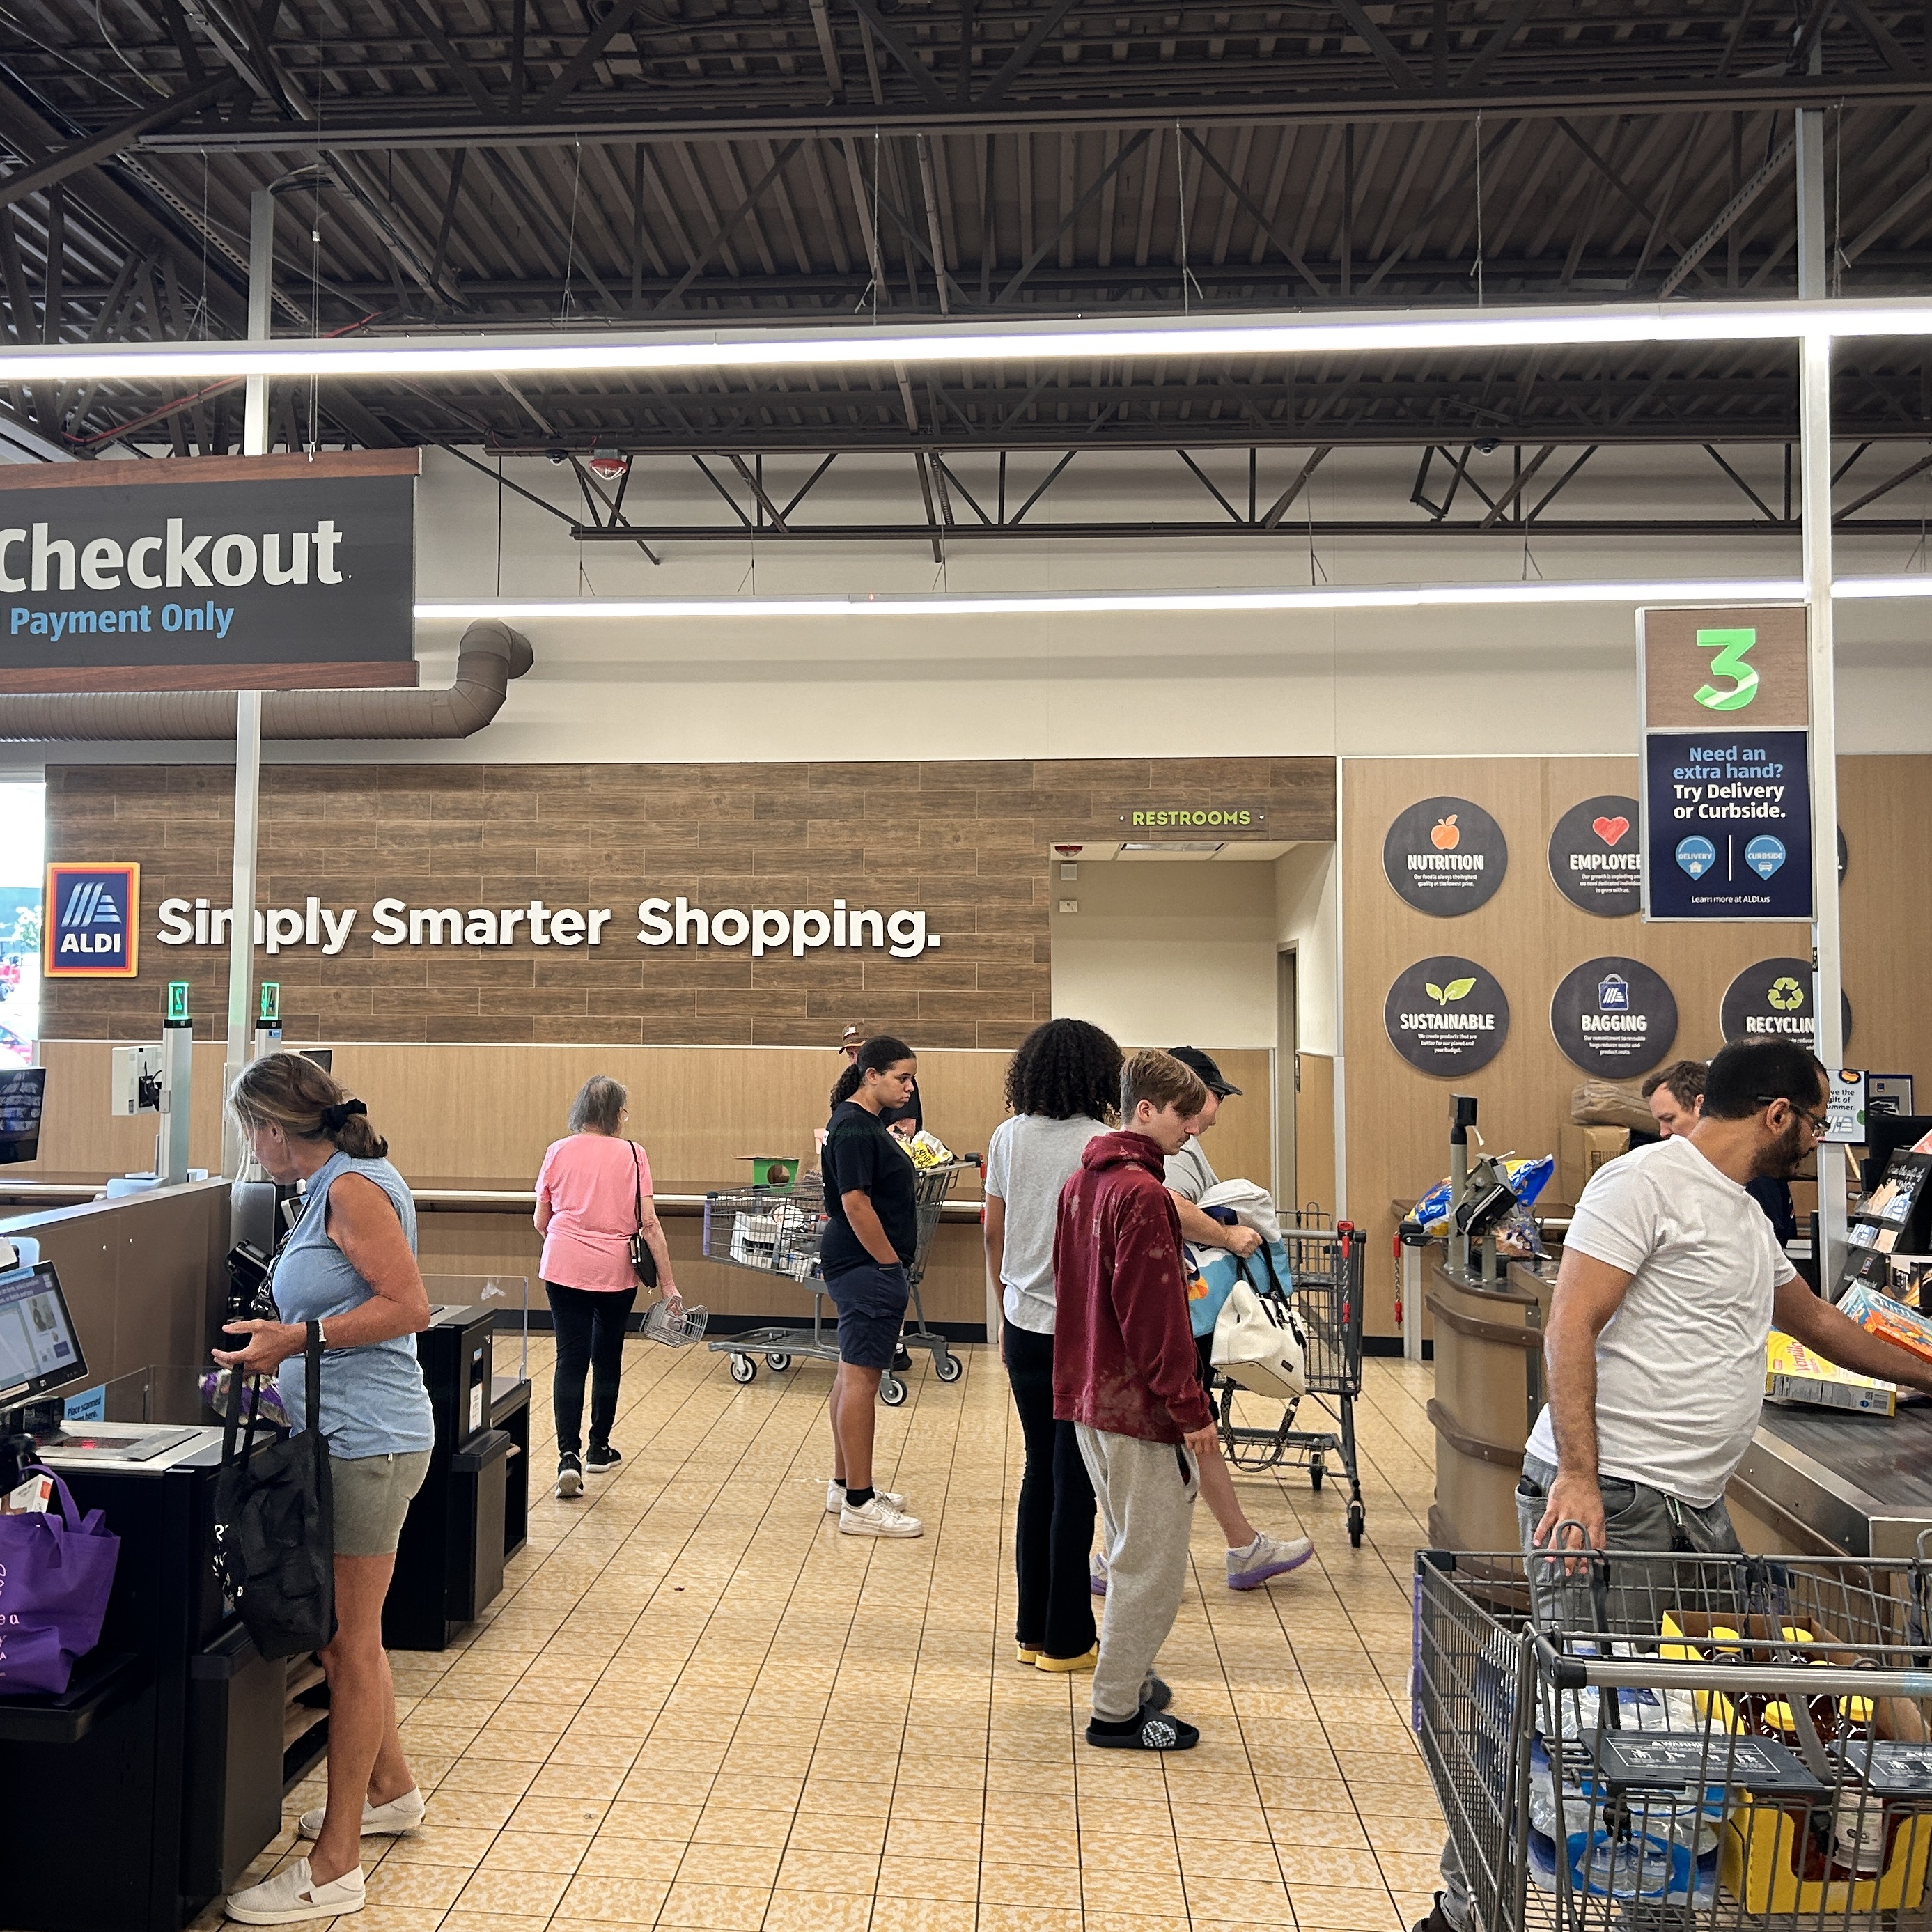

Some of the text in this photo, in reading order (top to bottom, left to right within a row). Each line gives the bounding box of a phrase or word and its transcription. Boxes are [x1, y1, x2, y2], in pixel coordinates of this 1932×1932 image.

[0, 518, 343, 593] Checkout
[10, 601, 235, 642] Payment Only
[1693, 628, 1759, 710] 3
[1689, 745, 1766, 762] Need an
[1673, 763, 1784, 779] extra hand?
[1673, 781, 1784, 803] Try Delivery
[1132, 811, 1251, 825] RESTROOMS
[1674, 802, 1786, 819] or Curbside.
[1407, 854, 1484, 871] NUTRITION
[1569, 854, 1642, 870] EMPLOYEE
[157, 896, 941, 958] Simply Smarter Shopping.
[60, 933, 121, 953] ALDI
[1400, 1013, 1495, 1030] SUSTAINABLE
[1581, 1015, 1648, 1032] BAGGING
[1746, 1016, 1814, 1034] RECYCLIN
[1786, 1341, 1811, 1373] Vanilla
[67, 1395, 102, 1417] Place scanned
